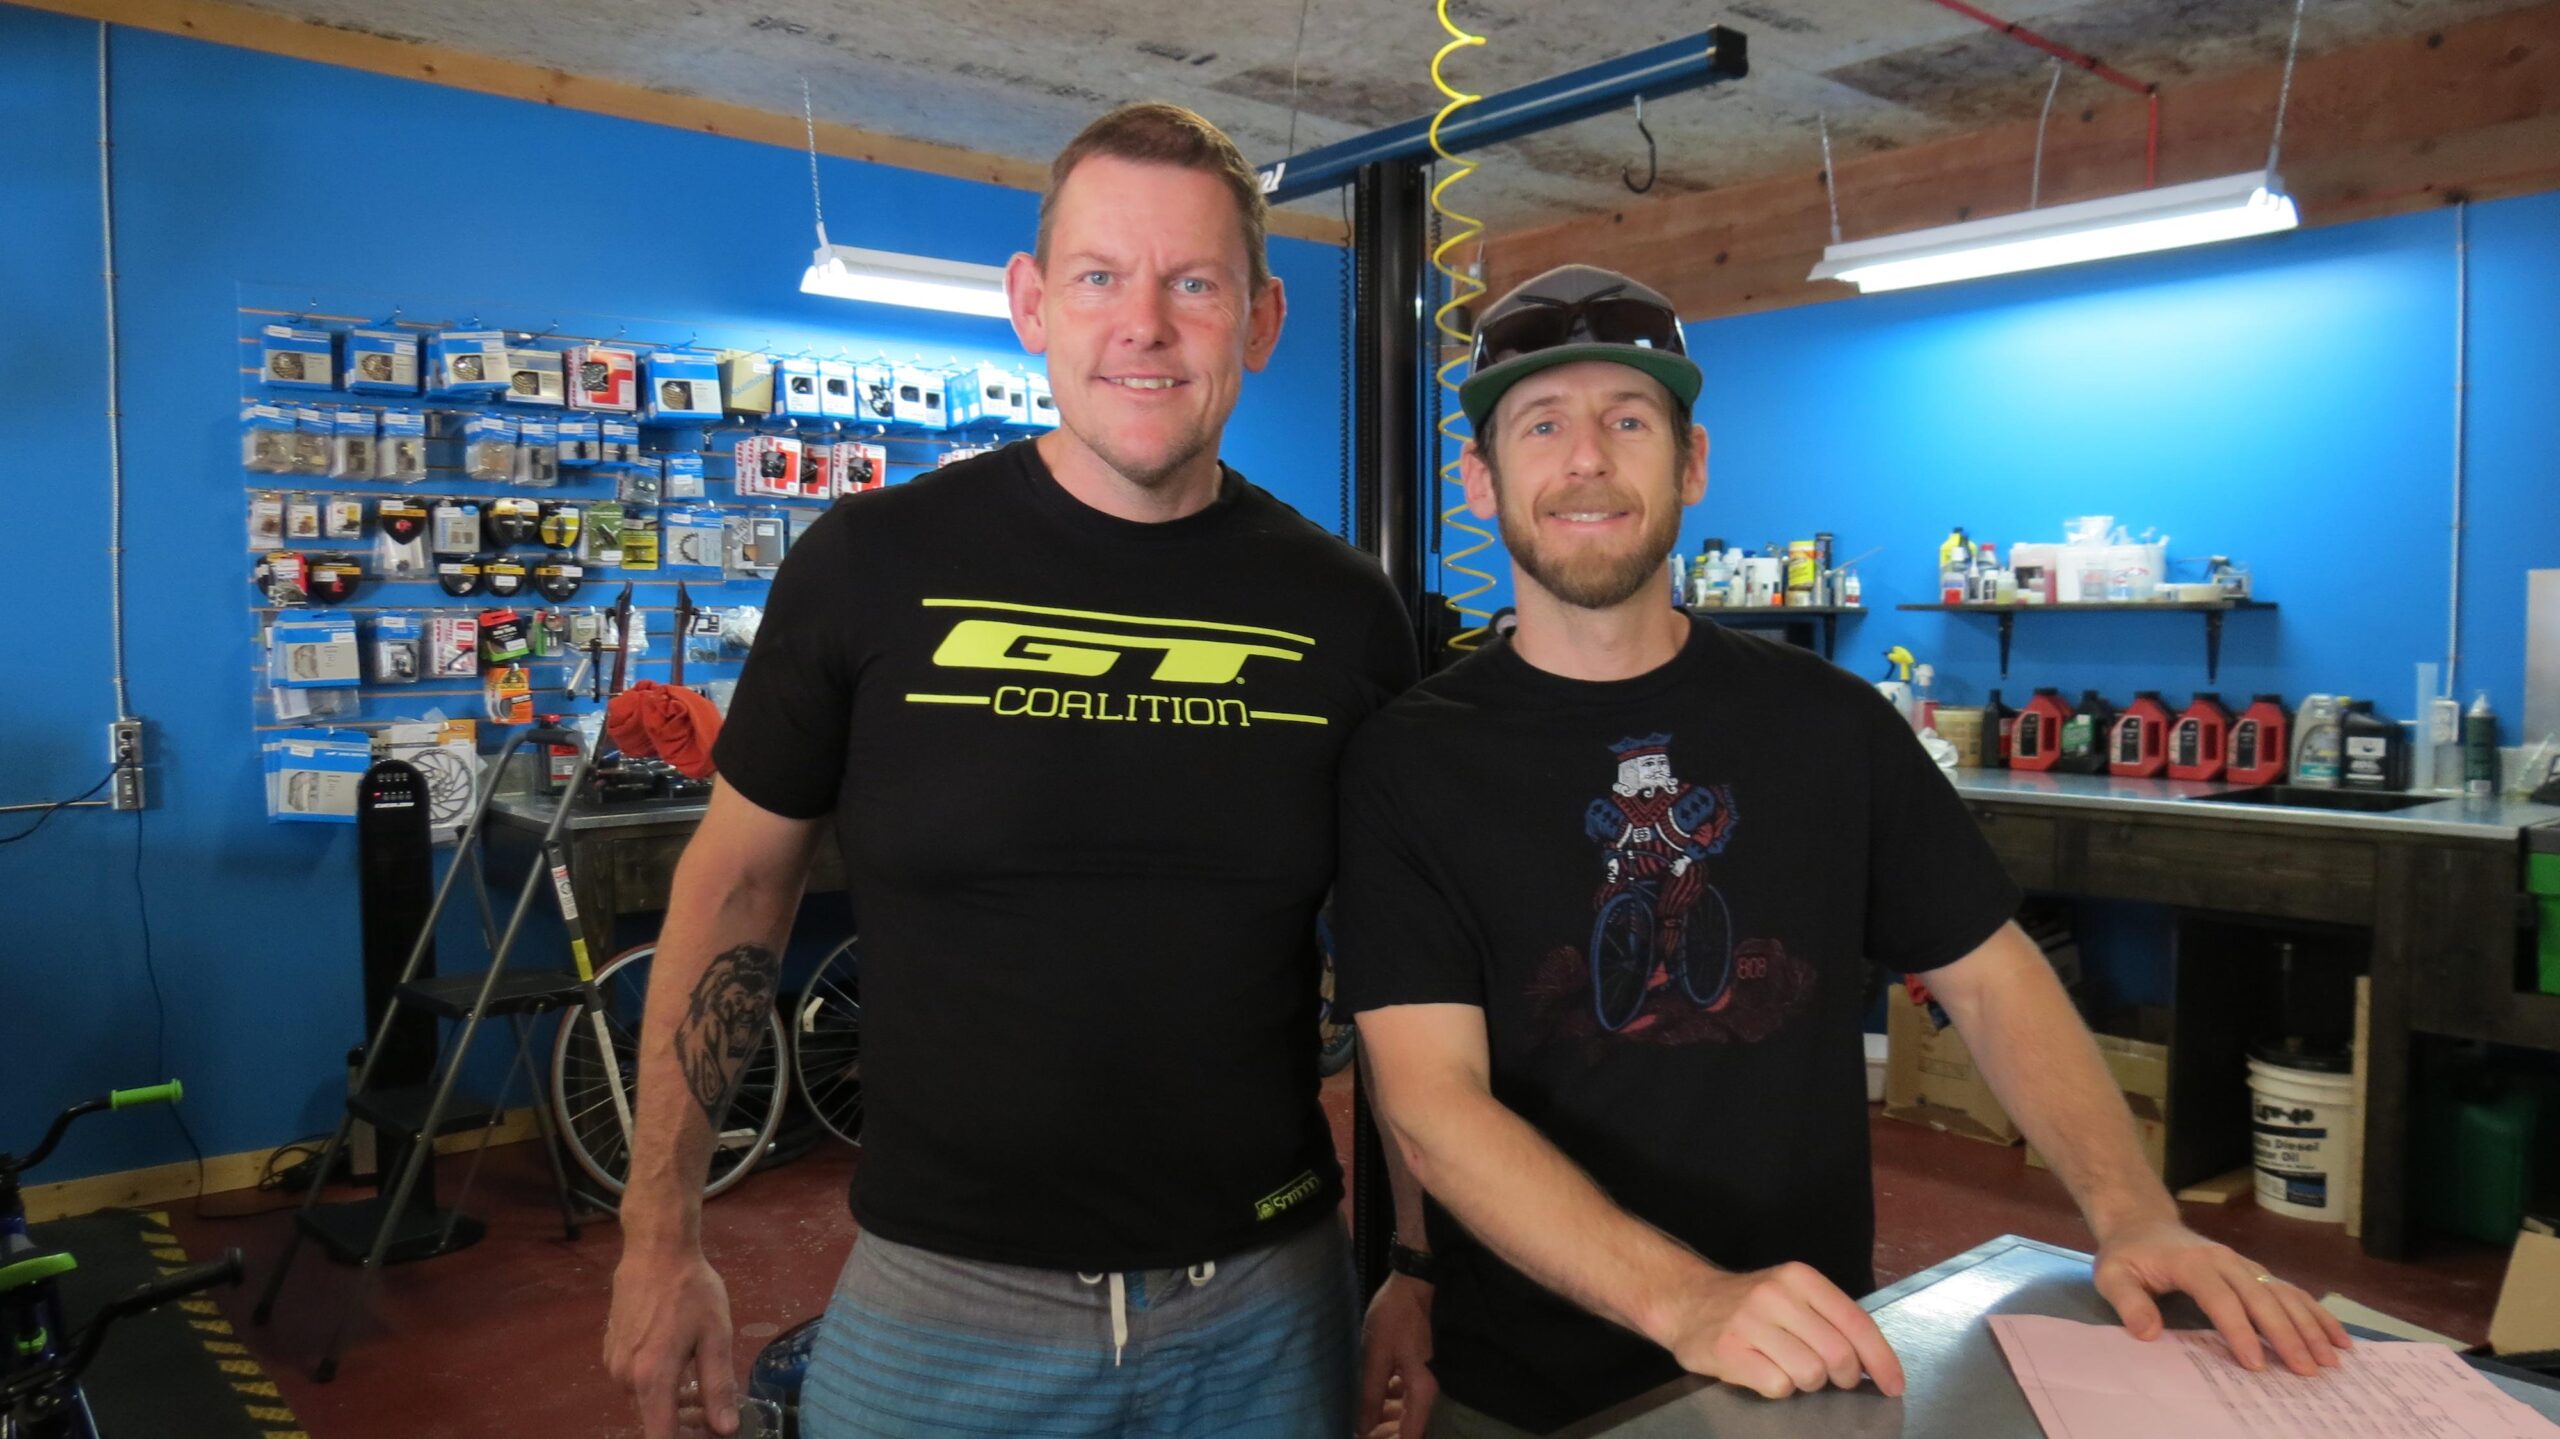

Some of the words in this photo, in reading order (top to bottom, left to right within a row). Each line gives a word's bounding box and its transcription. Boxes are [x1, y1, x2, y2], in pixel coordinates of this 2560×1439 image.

[932, 620, 1304, 684] GT
[993, 686, 1251, 727] COALITION
[1736, 957, 1767, 980] 808
[2274, 1139, 2320, 1152] Diesel
